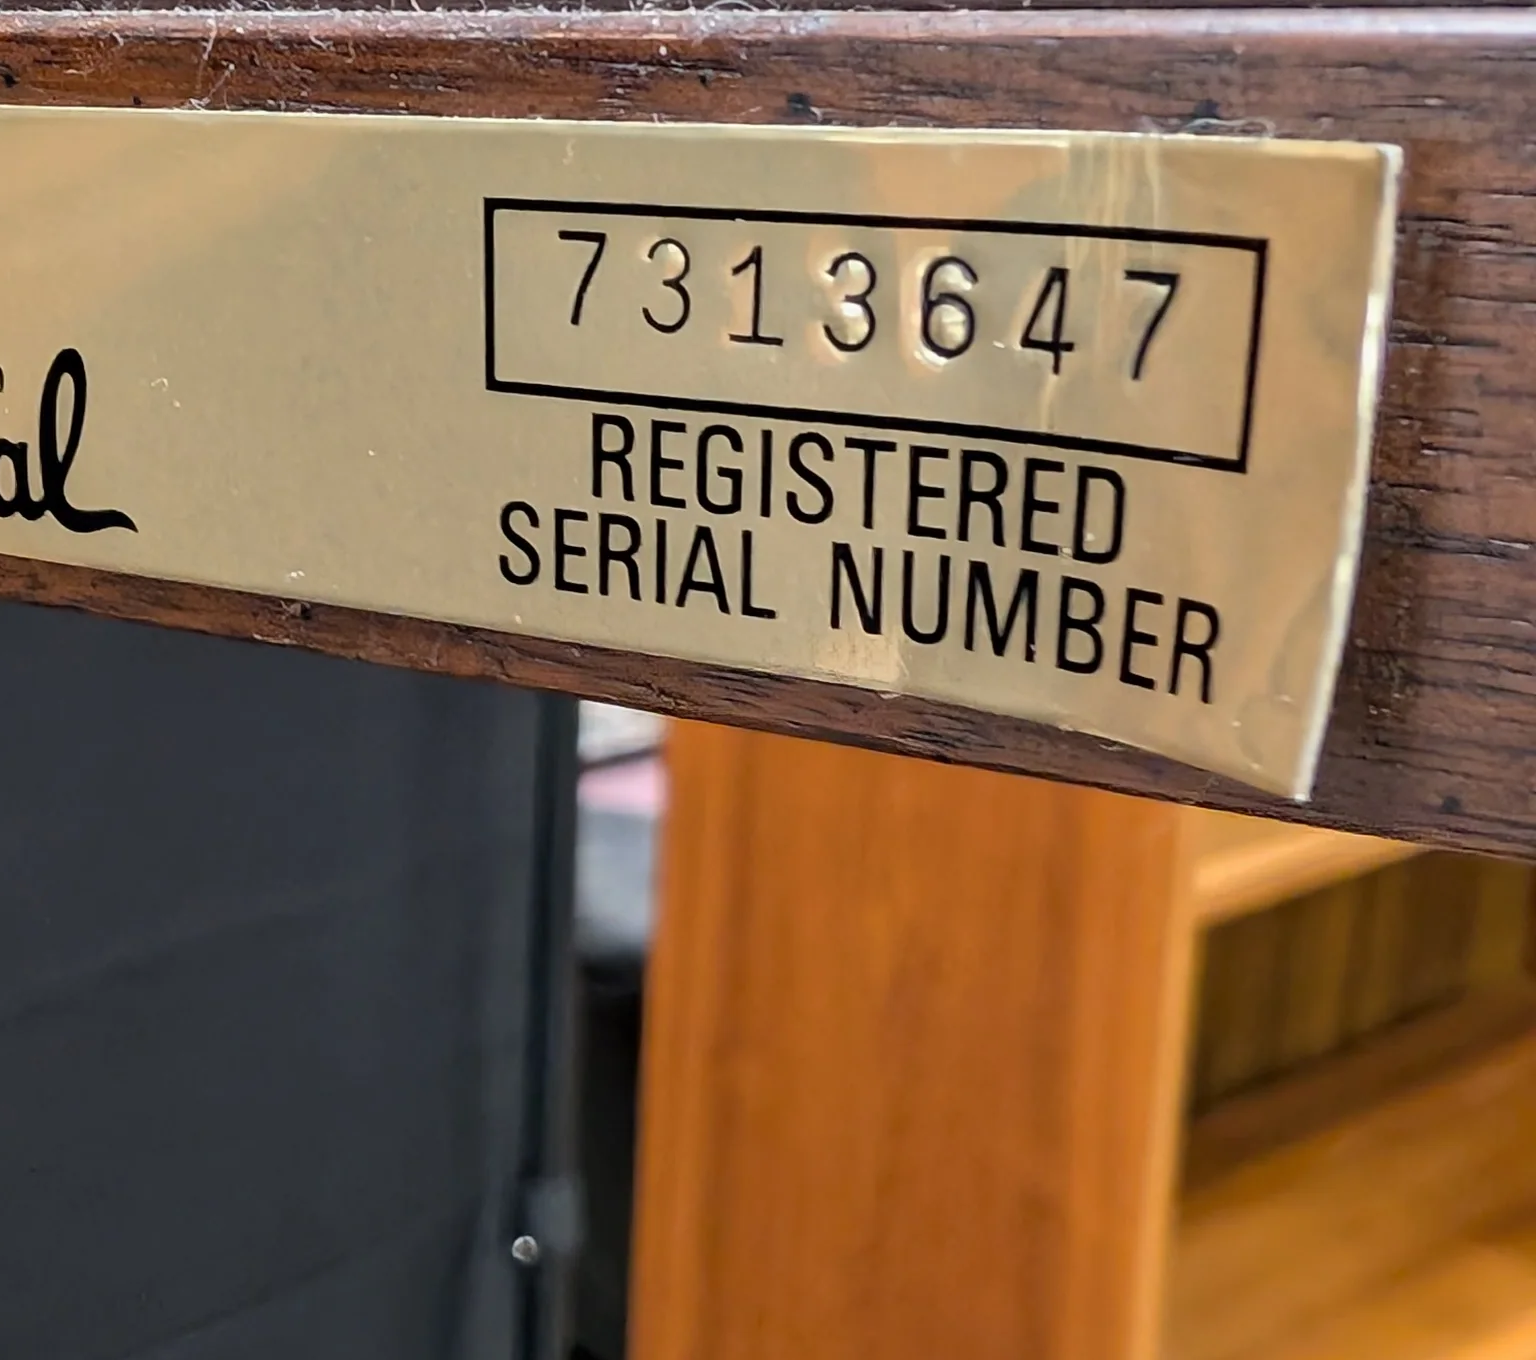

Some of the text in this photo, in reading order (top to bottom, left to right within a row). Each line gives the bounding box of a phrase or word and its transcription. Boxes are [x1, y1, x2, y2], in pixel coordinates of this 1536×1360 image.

[556, 229, 1182, 382] 7313647
[591, 413, 1127, 565] REGISTERED
[498, 500, 1221, 704] SERIAL NUMBER
